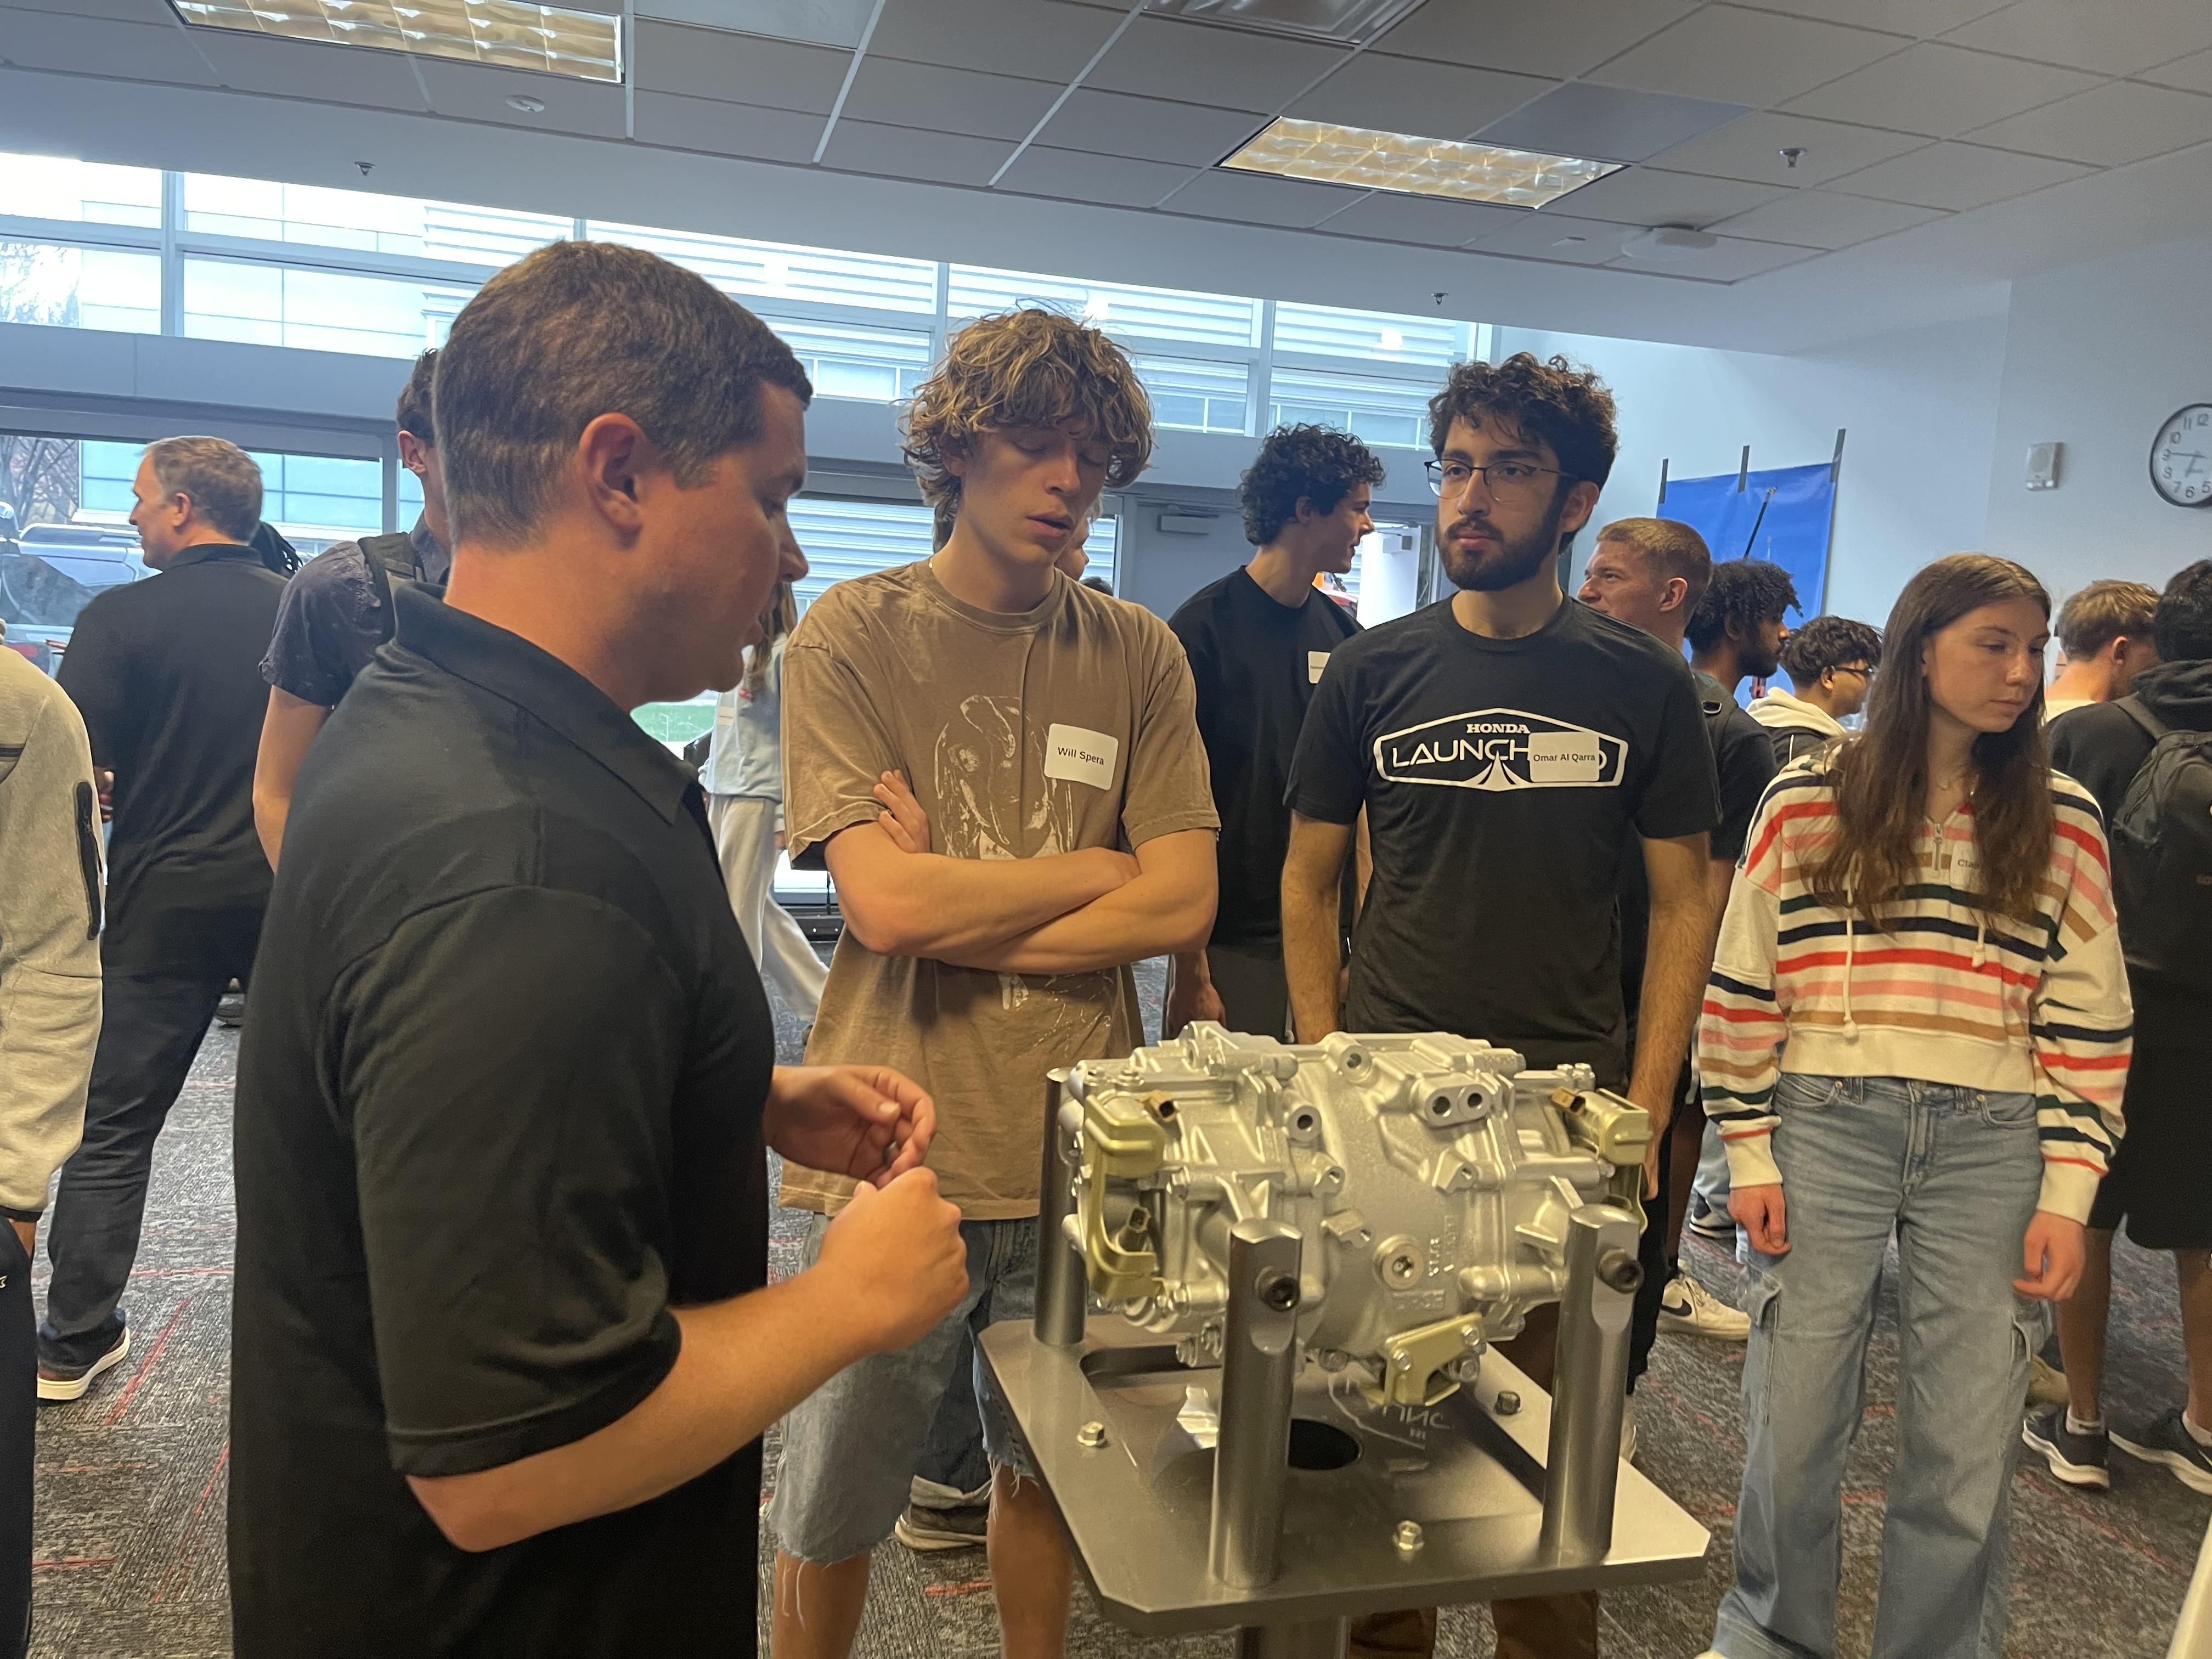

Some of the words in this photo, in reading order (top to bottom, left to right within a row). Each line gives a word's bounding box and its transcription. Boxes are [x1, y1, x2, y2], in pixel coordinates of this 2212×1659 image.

[2183, 415, 2192, 431] 11
[2196, 413, 2209, 426] 12
[2162, 449, 2171, 461] 9
[2163, 466, 2172, 479] 8
[2173, 481, 2182, 493] 7
[2186, 486, 2195, 499] 6
[2202, 481, 2211, 493] 5
[1466, 723, 1531, 734] HONDA
[1058, 747, 1076, 758] Will
[1079, 751, 1104, 765] Spera
[1392, 738, 1531, 768] LAUNCH
[1533, 754, 1558, 762] Omar
[1572, 753, 1595, 763] Qarra
